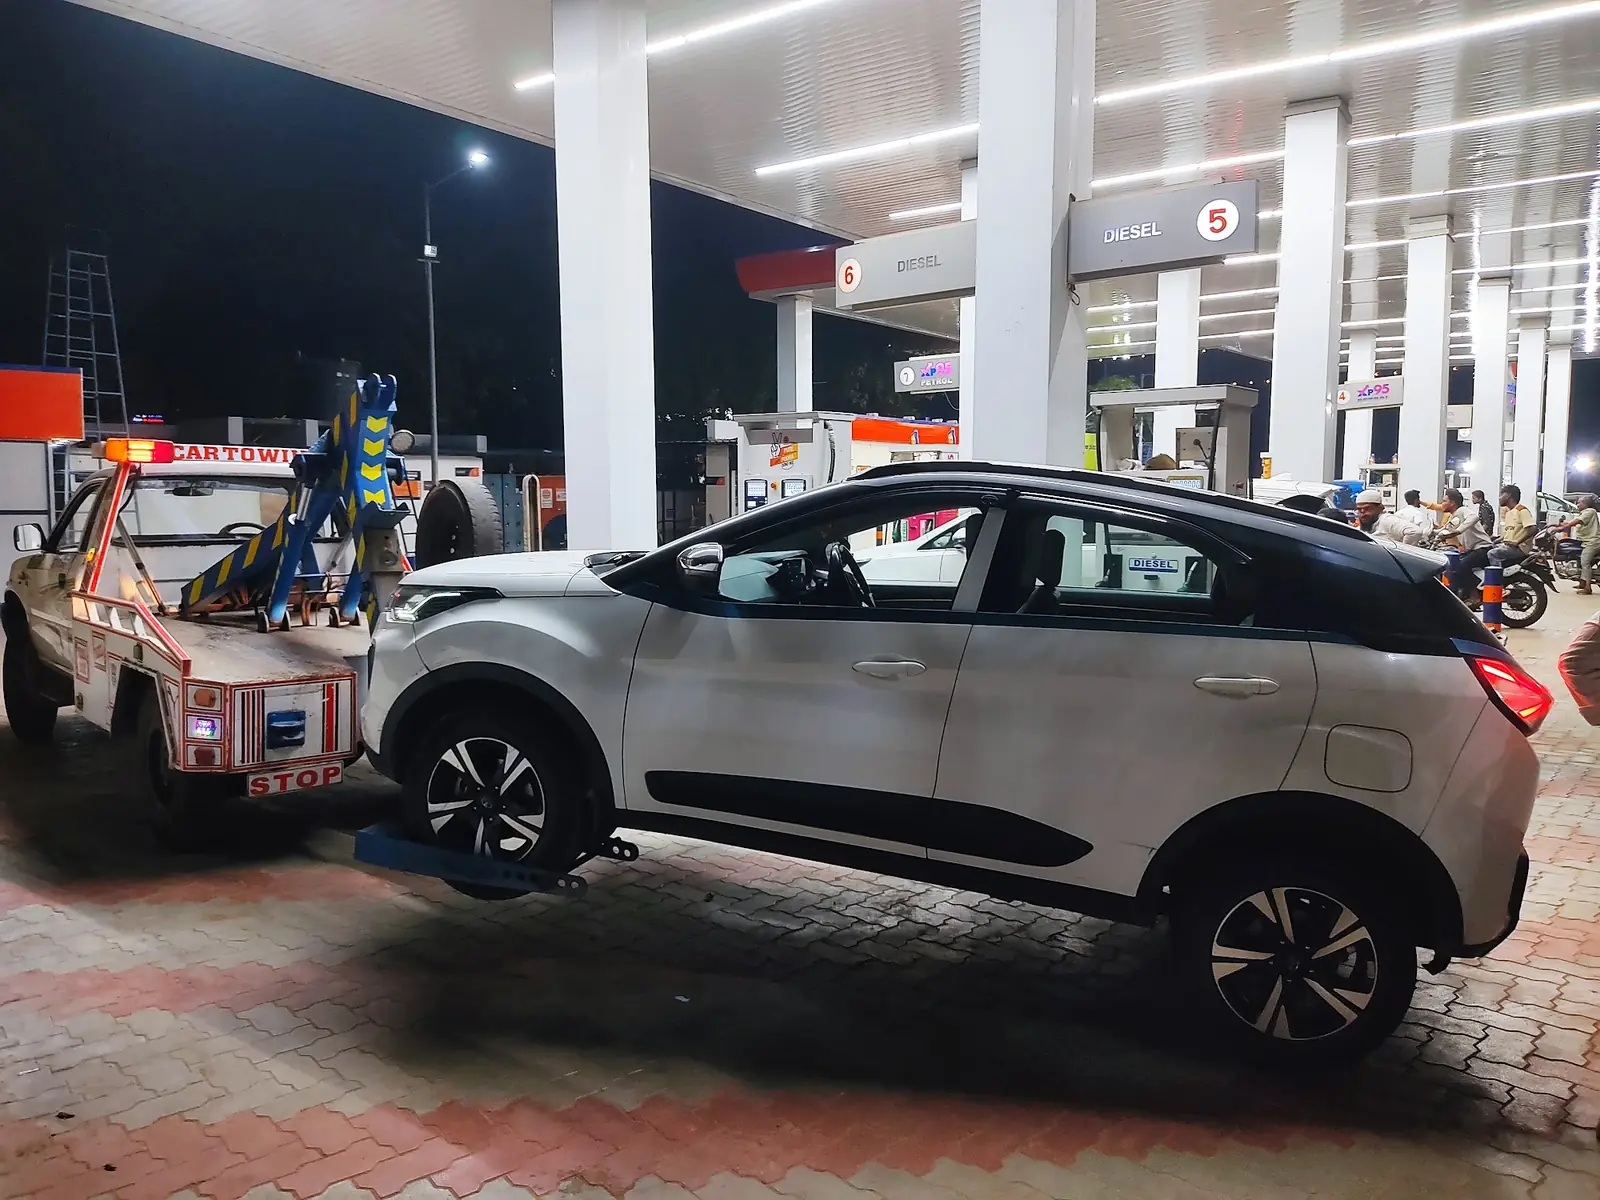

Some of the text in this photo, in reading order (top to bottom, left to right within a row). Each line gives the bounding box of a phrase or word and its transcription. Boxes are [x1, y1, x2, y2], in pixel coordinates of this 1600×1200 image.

[1103, 208, 1228, 244] DIESEL 5
[843, 253, 942, 286] 6 DIESEL
[920, 378, 953, 387] PETROL
[1338, 391, 1346, 401] 4
[173, 445, 219, 461] CAR
[1133, 559, 1174, 569] DIESEL
[250, 766, 341, 798] STOP
